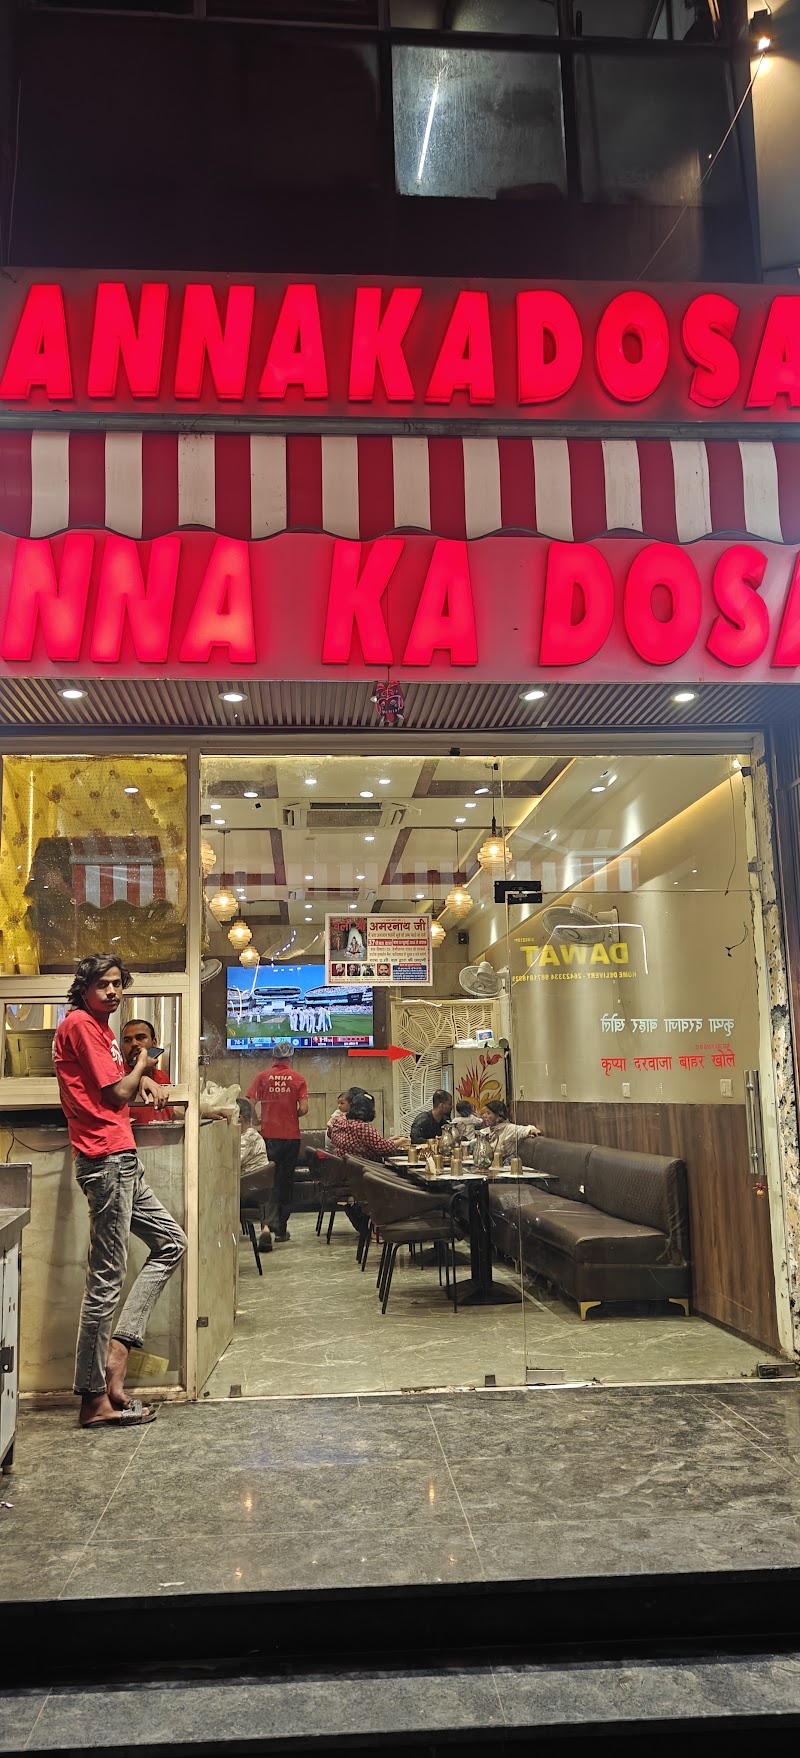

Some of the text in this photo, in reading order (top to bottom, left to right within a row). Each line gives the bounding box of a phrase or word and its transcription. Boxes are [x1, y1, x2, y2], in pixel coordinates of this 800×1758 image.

[321, 536, 478, 667] KA
[369, 921, 411, 931] अमरनाथ
[413, 918, 427, 931] जी
[633, 1056, 672, 1071] दरवाजा
[678, 1055, 705, 1070] बाहर
[711, 1049, 736, 1068] खोले
